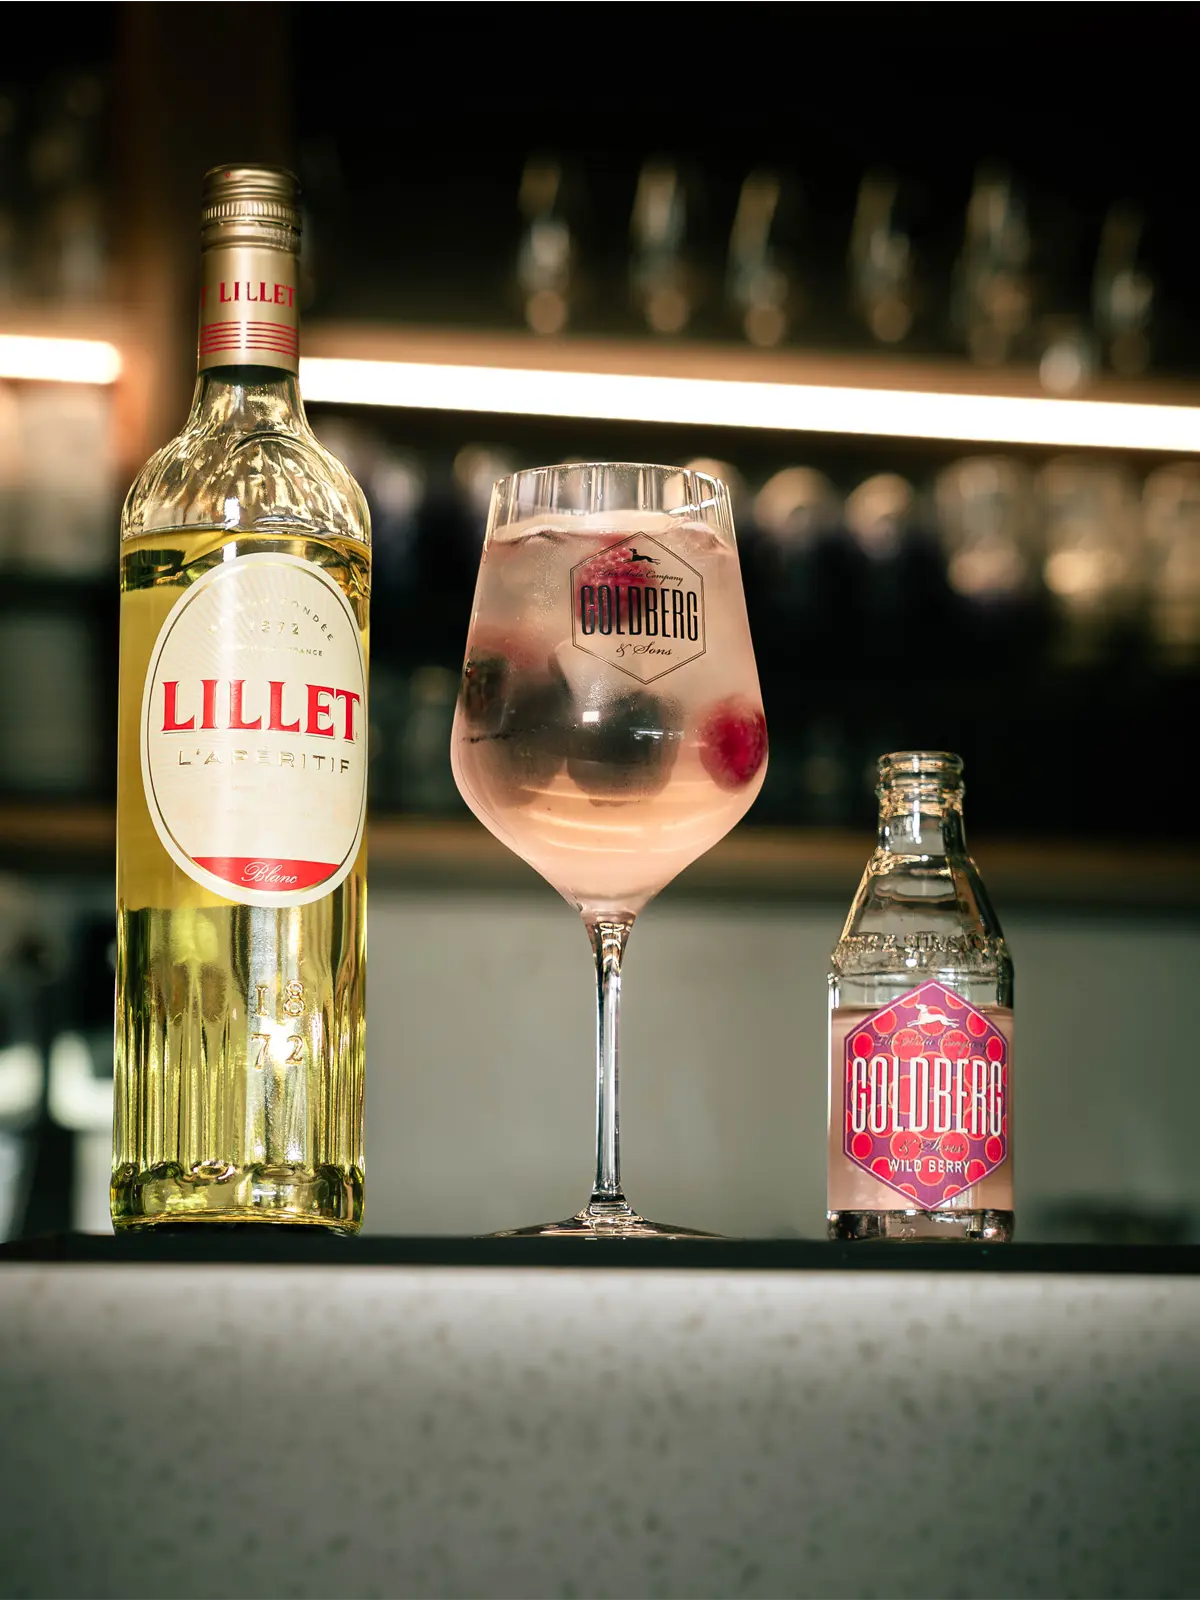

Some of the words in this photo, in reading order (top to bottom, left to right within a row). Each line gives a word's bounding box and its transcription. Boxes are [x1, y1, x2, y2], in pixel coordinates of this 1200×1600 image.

[219, 281, 297, 308] LILLET
[645, 568, 684, 587] Company
[580, 585, 699, 642] GOLDBERG
[616, 642, 633, 658] &
[632, 641, 673, 656] Sons
[161, 679, 361, 742] LILLET
[177, 744, 351, 774] L'APÉRITIF
[240, 861, 298, 884] Blanc
[851, 1056, 1003, 1137] GOLDBERG
[888, 1159, 922, 1173] WILD
[928, 1159, 971, 1175] BERRY
